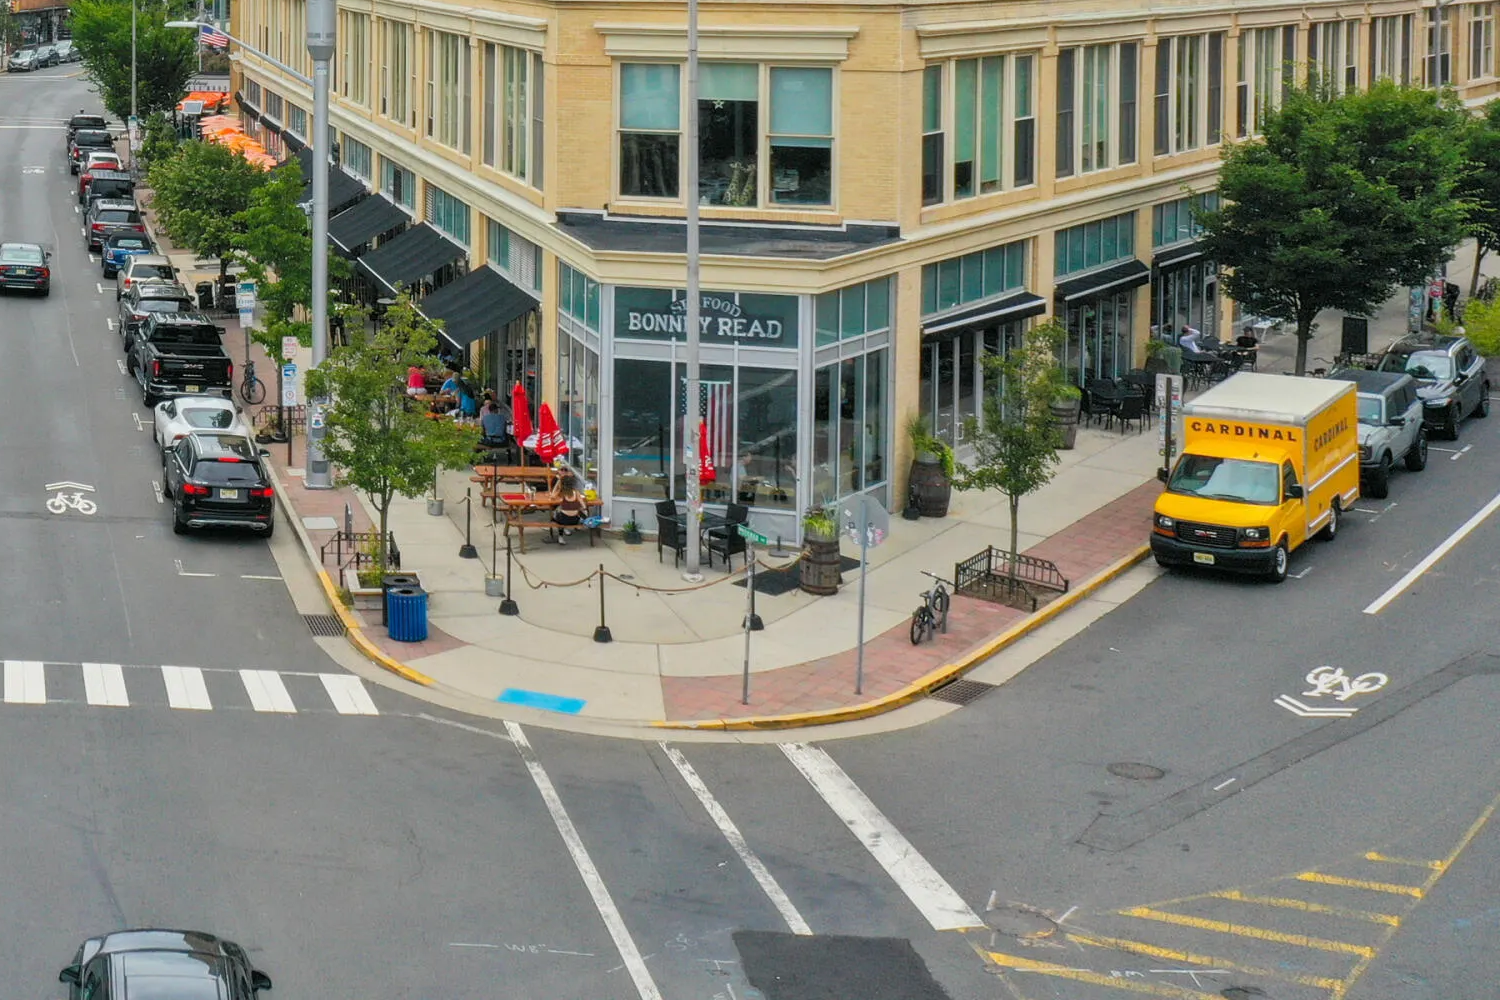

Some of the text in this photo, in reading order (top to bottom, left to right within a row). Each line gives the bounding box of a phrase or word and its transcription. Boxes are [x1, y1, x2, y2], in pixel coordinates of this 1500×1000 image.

[670, 296, 741, 318] SEFOOD
[628, 311, 782, 339] BONNY READ
[1191, 421, 1297, 442] CARDINAL
[1313, 417, 1349, 452] CARDINAL
